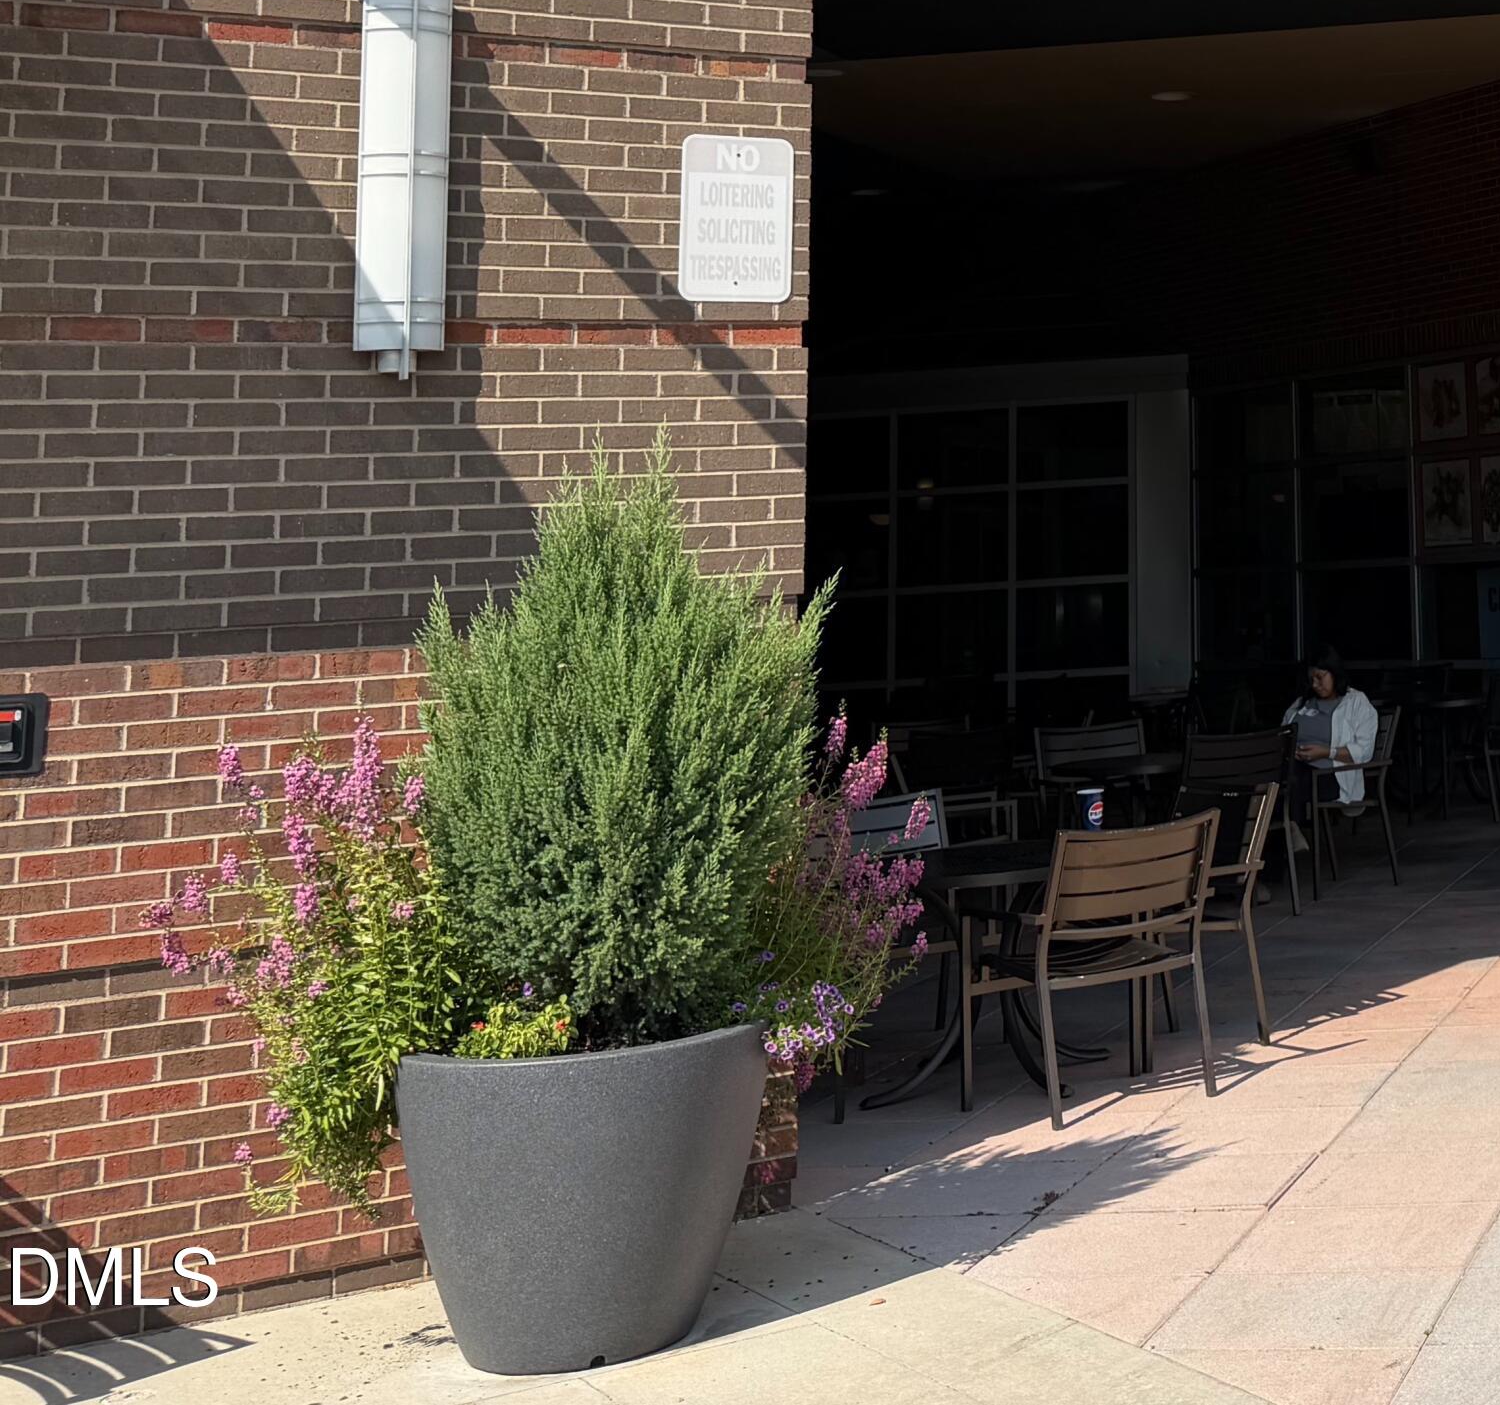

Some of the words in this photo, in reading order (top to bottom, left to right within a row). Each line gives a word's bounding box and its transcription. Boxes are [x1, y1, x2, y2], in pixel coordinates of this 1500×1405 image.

[715, 143, 761, 172] NO
[700, 181, 774, 208] LOITERING
[697, 218, 776, 245] SOLICITING
[689, 255, 781, 281] TRESPASSING
